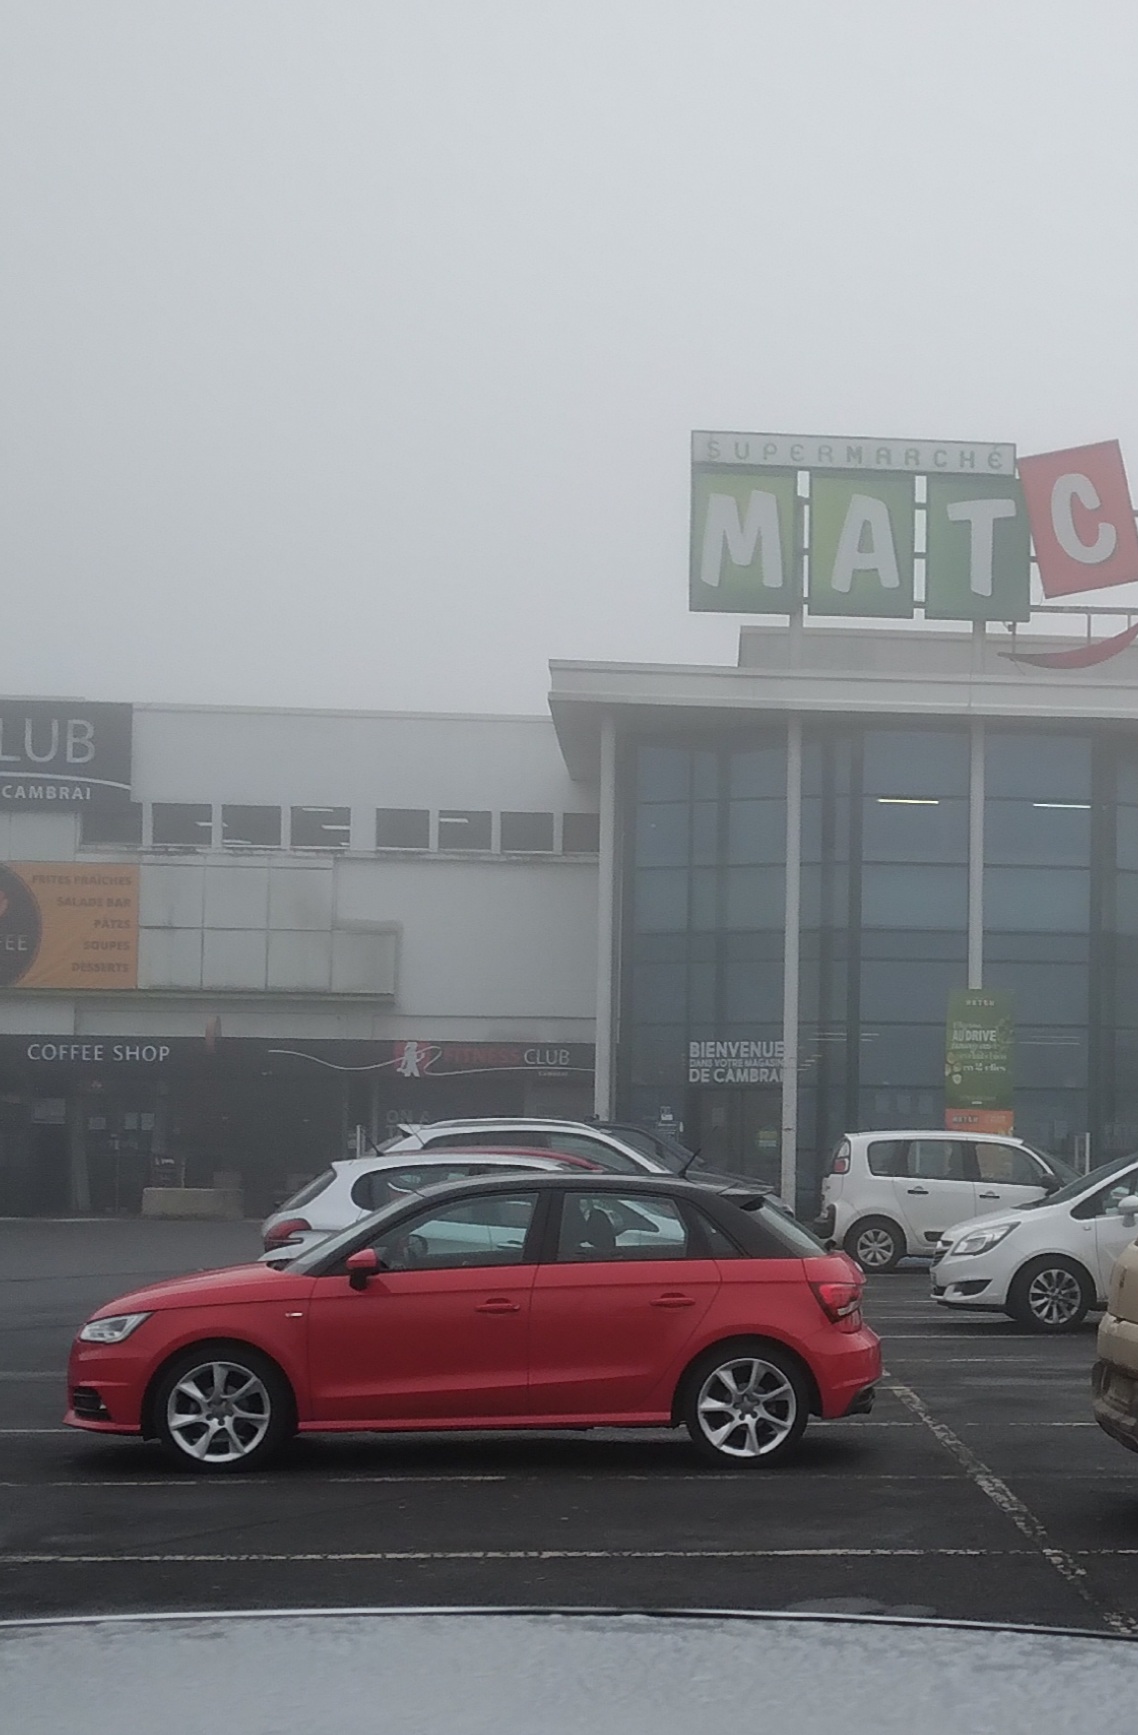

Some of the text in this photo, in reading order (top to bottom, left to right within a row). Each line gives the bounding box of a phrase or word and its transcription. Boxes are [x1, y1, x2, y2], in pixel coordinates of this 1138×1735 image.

[0, 718, 95, 763] LUB
[2, 785, 91, 800] CAMBRAI
[32, 875, 71, 885] FRITES
[57, 897, 131, 907] SALADE BAR
[0, 934, 27, 951] EE
[83, 941, 130, 950] SOUPES
[72, 962, 129, 972] DESSERTS
[965, 1030, 997, 1042] DRIVE
[27, 1044, 170, 1061] COFFEE SHOP
[524, 1049, 570, 1065] CLUB
[689, 1041, 784, 1058] BIENVENUE
[689, 1068, 710, 1083] DE
